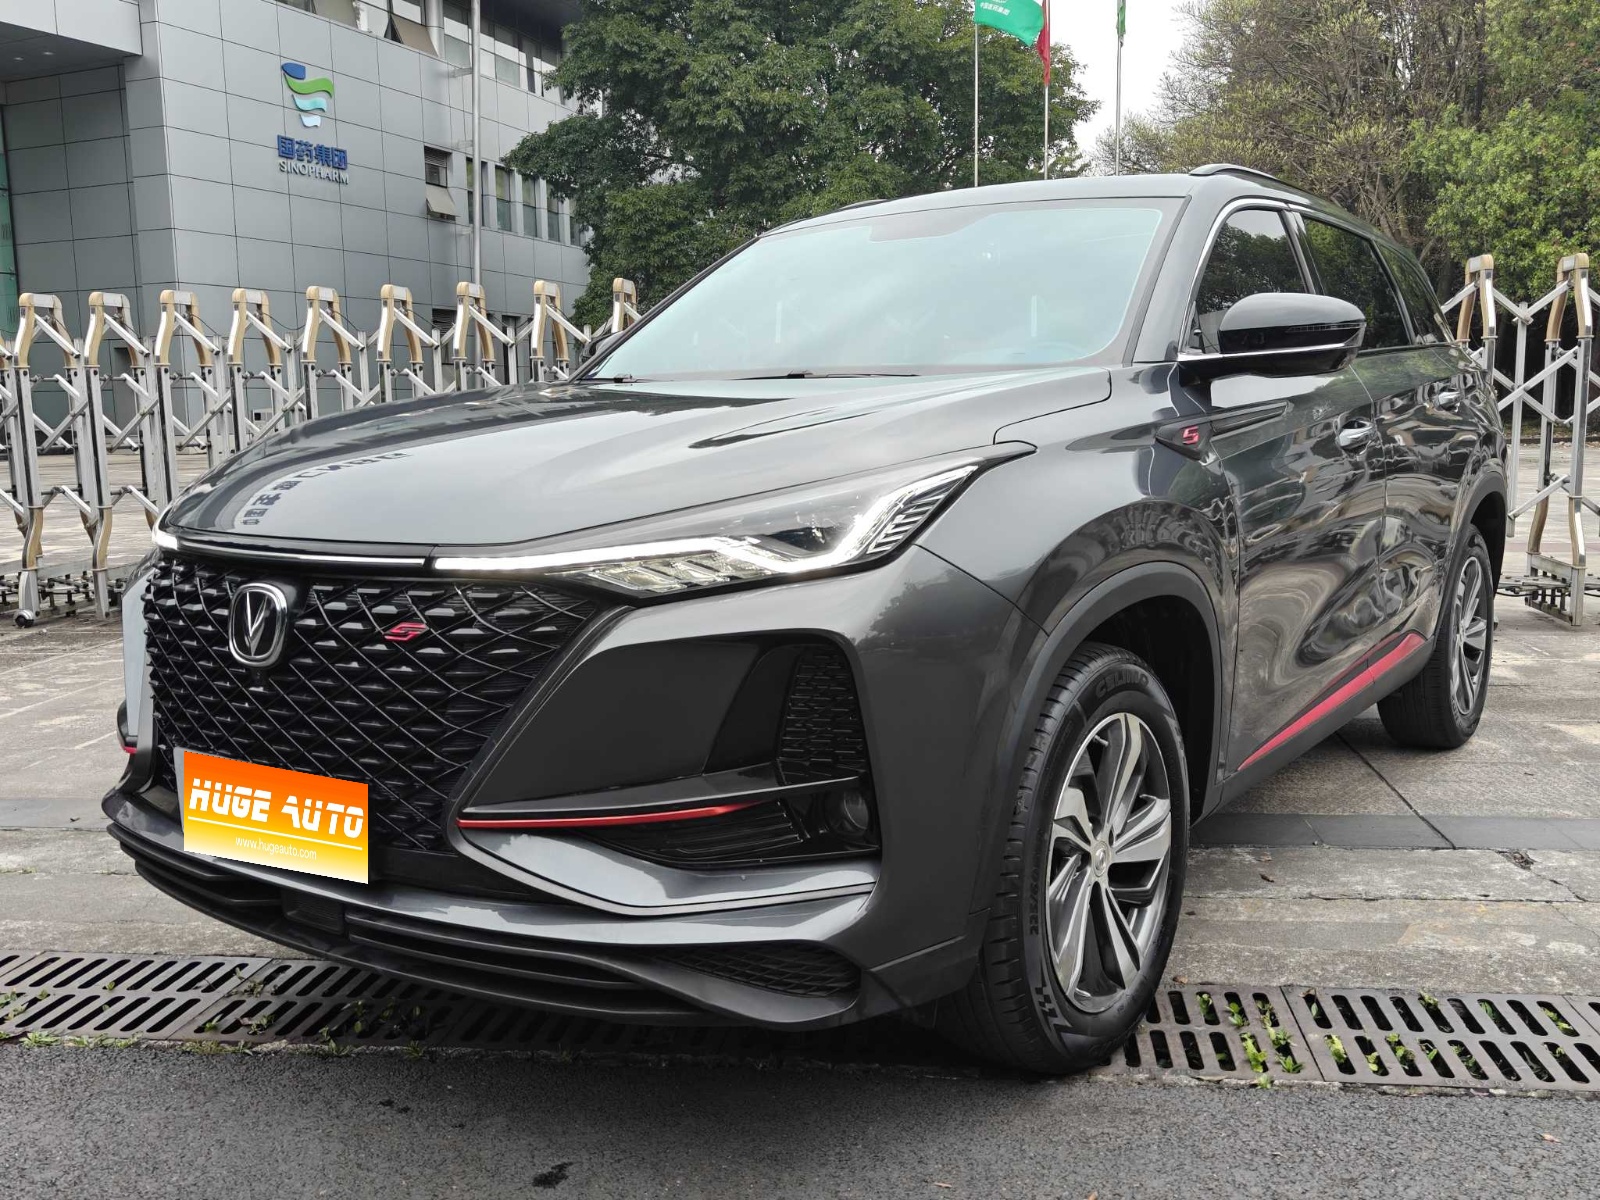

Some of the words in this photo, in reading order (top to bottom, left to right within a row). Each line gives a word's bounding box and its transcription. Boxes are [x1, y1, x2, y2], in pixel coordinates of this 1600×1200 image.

[277, 134, 348, 171] 国药集团
[279, 159, 349, 185] SINOPHARM
